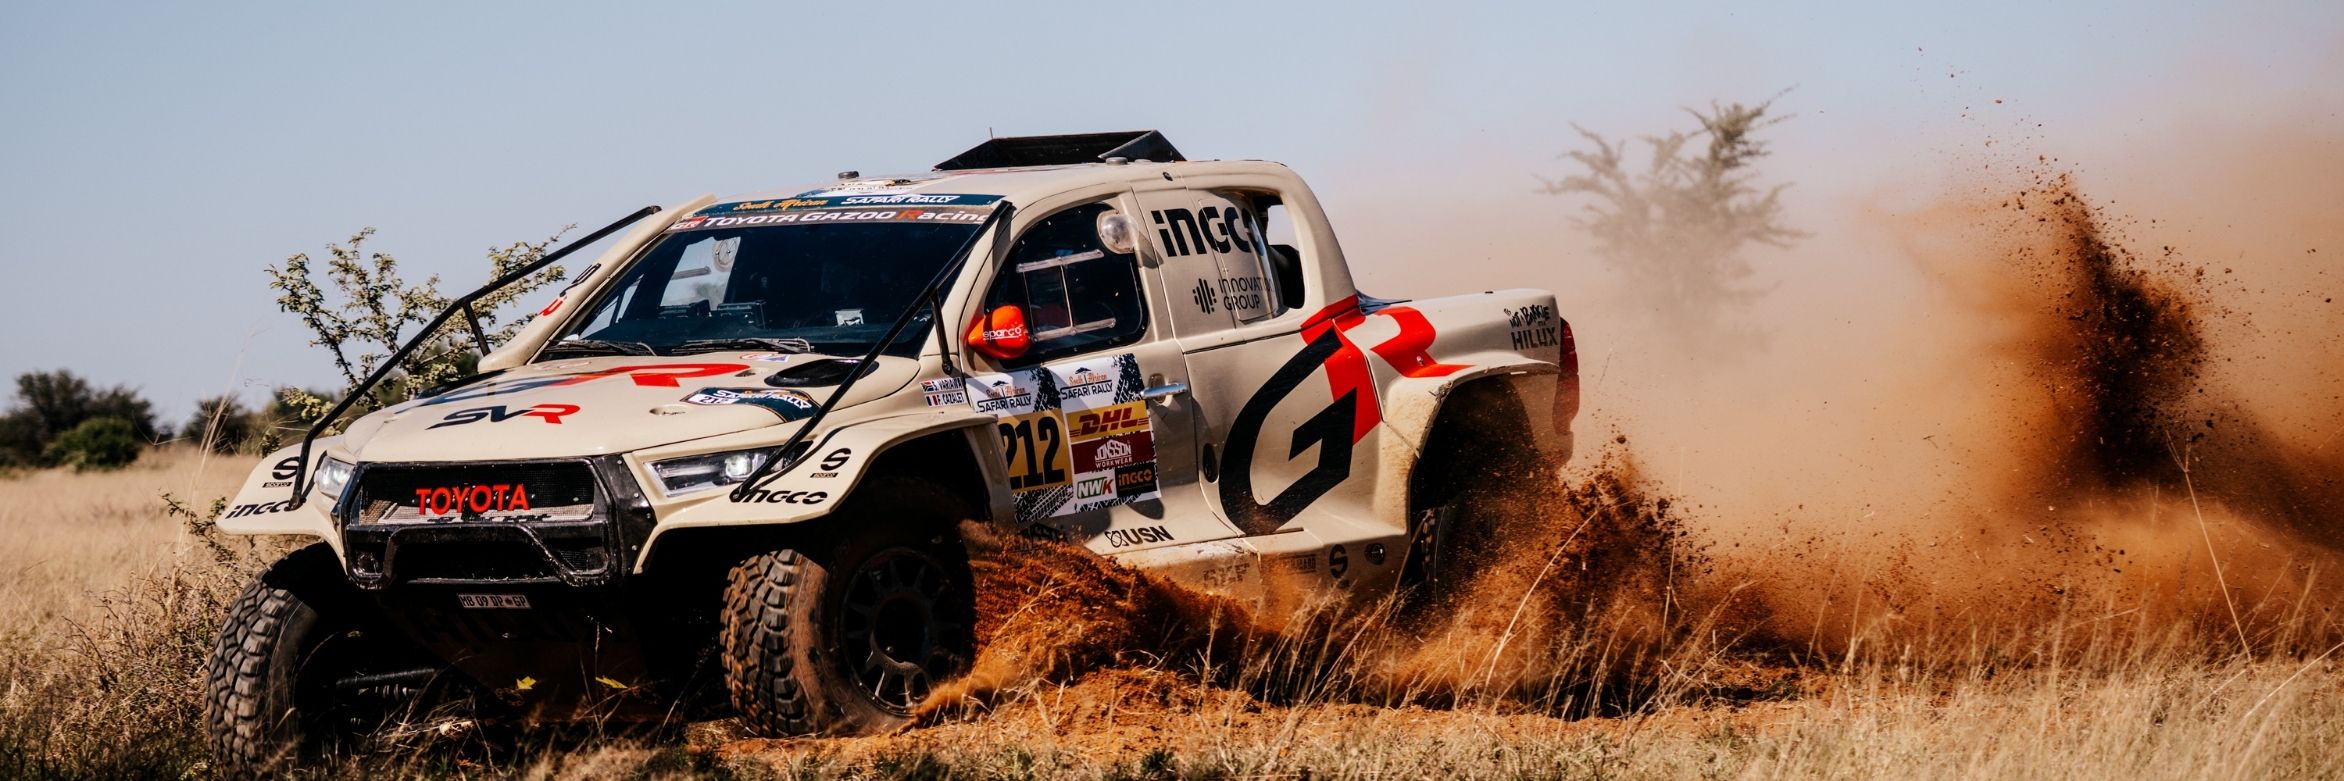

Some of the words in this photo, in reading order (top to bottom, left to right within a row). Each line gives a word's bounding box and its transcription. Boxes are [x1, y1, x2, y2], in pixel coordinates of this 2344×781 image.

[841, 194, 905, 204] SAFARI
[905, 194, 960, 204] RALLY
[704, 214, 800, 227] TOYOTA
[800, 211, 897, 223] GAZOO
[896, 209, 989, 224] Racing
[1223, 294, 1260, 311] GROUP
[1511, 327, 1558, 351] HILUX
[1060, 386, 1091, 400] SAFARI
[1092, 382, 1113, 395] RALLY
[977, 398, 1009, 413] SAFARI
[1010, 396, 1032, 409] RALLY
[425, 404, 581, 430] SVR
[1079, 407, 1138, 436] DHL
[999, 416, 1066, 490] 212
[1094, 439, 1132, 460] JONSSON
[1096, 457, 1132, 468] WORKWEAR
[1077, 477, 1114, 499] NWK
[416, 483, 530, 515] TOYOTA
[1121, 525, 1175, 545] USN
